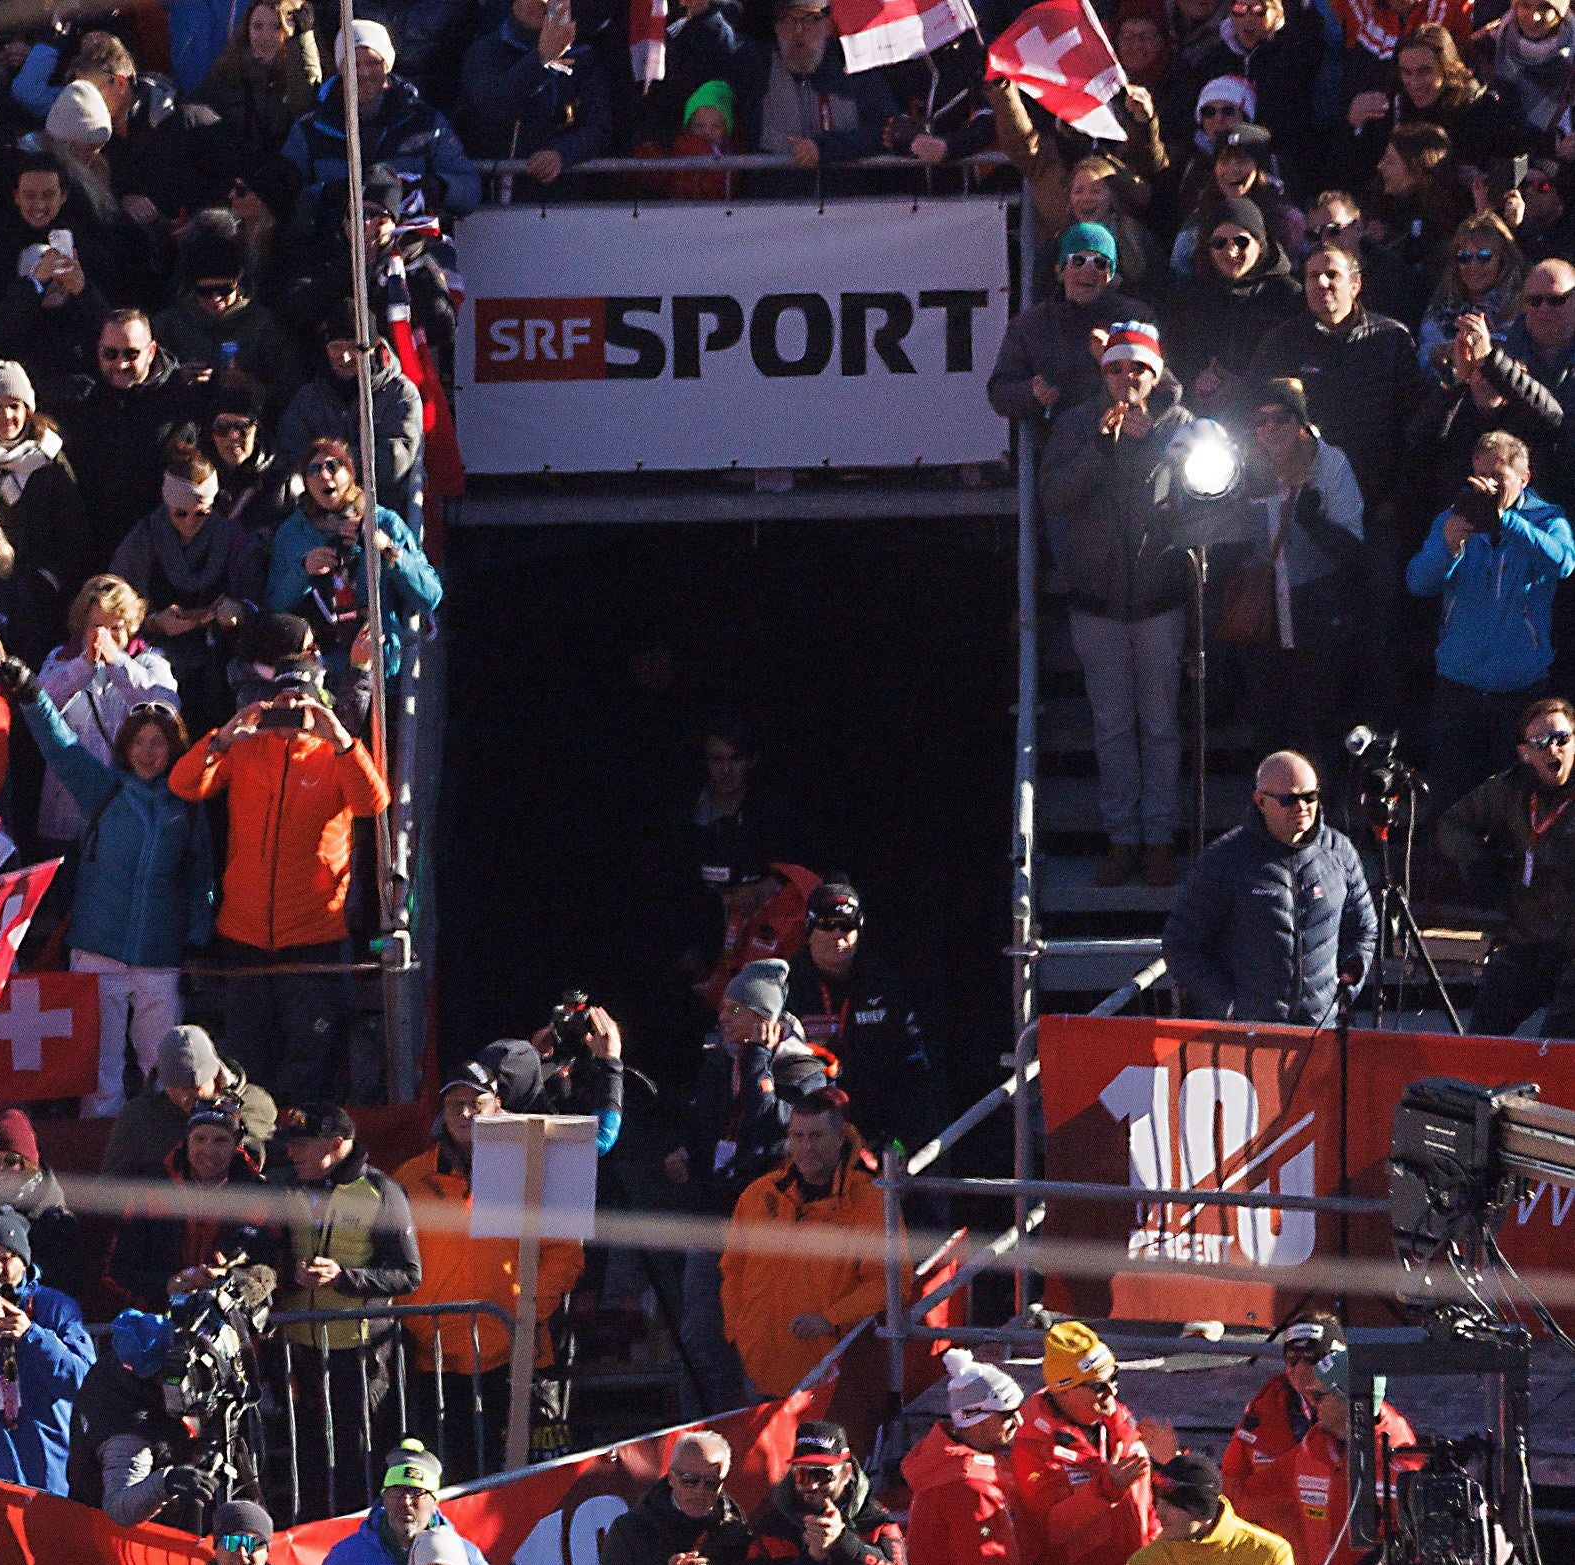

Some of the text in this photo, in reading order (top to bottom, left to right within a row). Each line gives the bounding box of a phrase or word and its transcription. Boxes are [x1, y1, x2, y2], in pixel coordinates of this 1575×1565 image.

[487, 289, 989, 381] SRF SPORT
[1127, 1228, 1236, 1264] PERCENT
